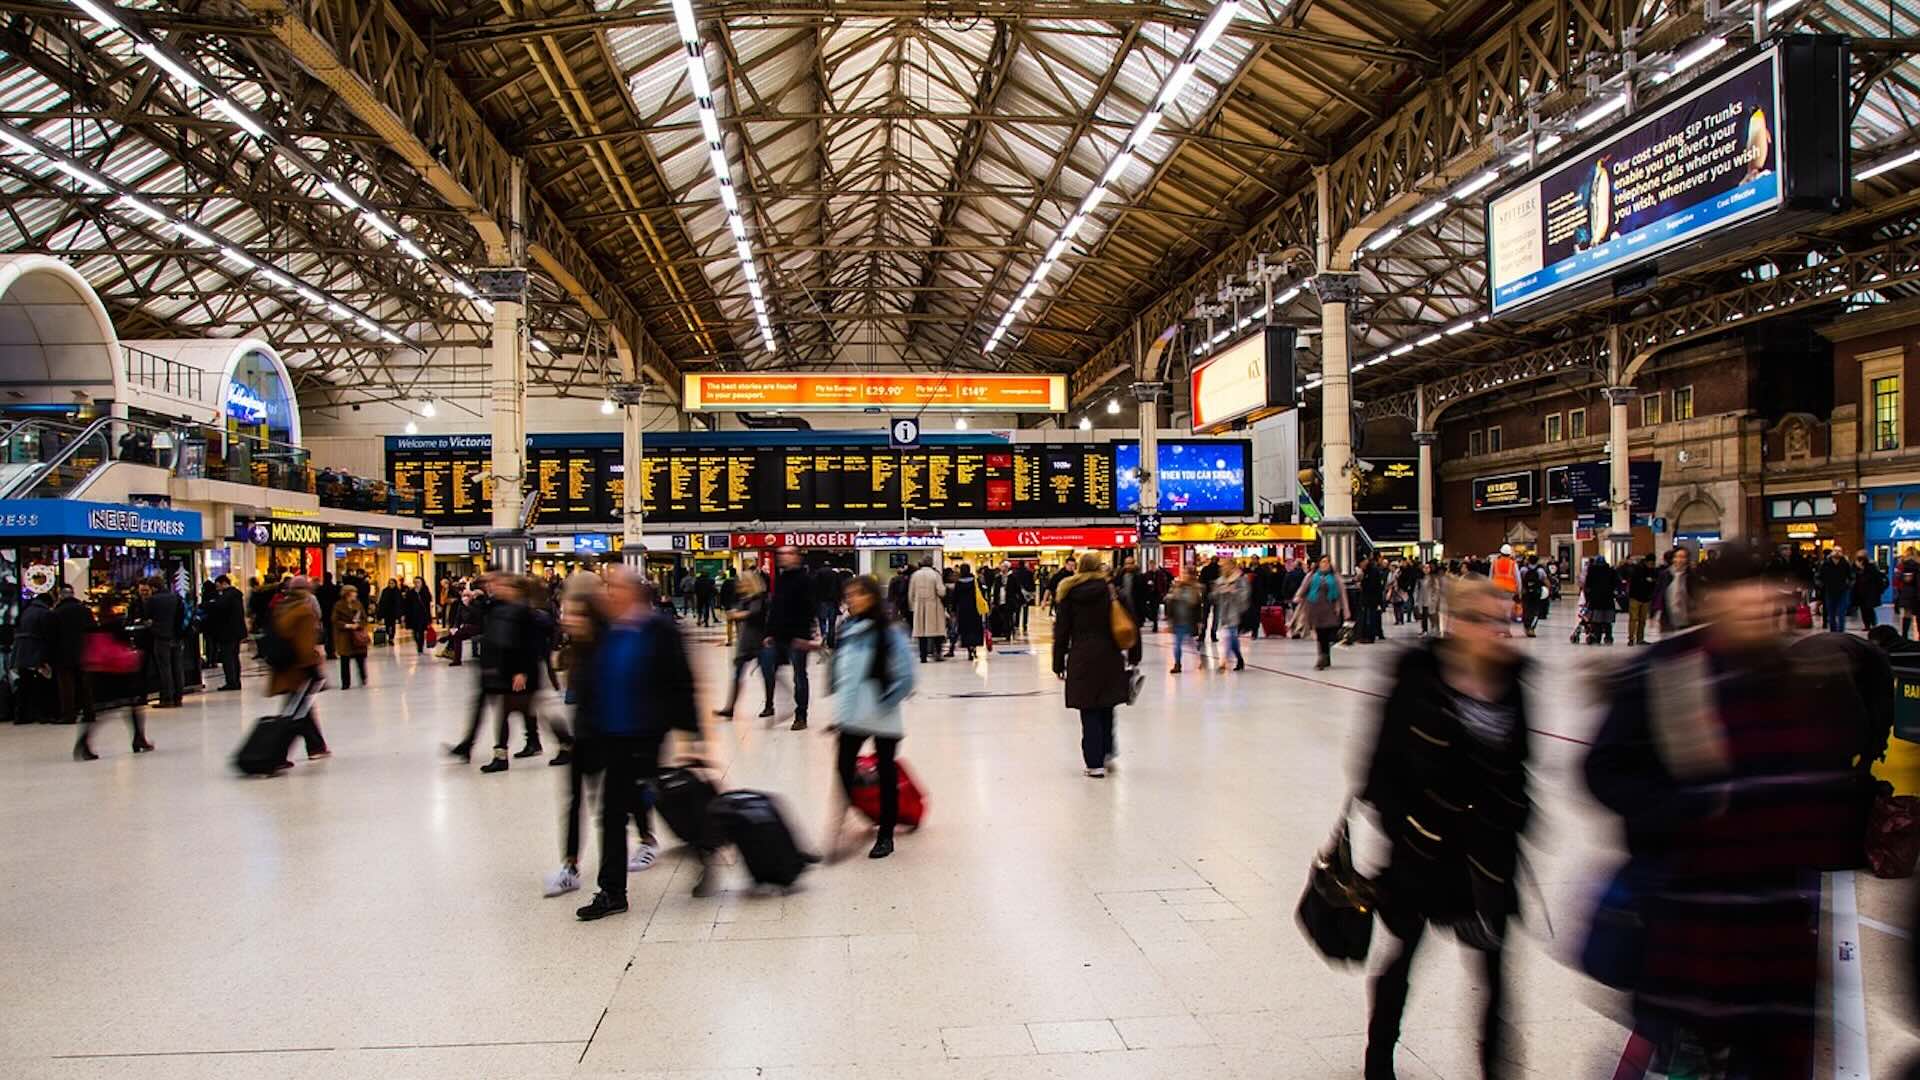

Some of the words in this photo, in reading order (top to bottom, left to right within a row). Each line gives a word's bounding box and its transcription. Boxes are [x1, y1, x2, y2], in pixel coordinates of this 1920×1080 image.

[1613, 159, 1630, 175] Our
[1631, 148, 1651, 166] cost
[1652, 131, 1684, 156] saving
[1685, 121, 1702, 139] SIP
[1704, 101, 1743, 129] Trunks
[1614, 167, 1645, 190] enable
[1645, 158, 1664, 179] you
[1664, 152, 1676, 166] to
[1678, 135, 1708, 160] divert
[1710, 122, 1736, 148] your
[1614, 176, 1660, 205] telephone
[1661, 164, 1684, 184] calls
[1685, 139, 1737, 172] wherever
[1614, 206, 1632, 223] you
[1633, 193, 1657, 212] wish,
[1658, 169, 1709, 198] whenever
[1710, 160, 1732, 182] you
[1733, 144, 1760, 167] wish
[1717, 198, 1729, 209] Cost
[1730, 188, 1757, 204] Effective
[706, 382, 720, 390] The
[721, 382, 737, 390] best
[738, 382, 762, 390] stories
[776, 382, 797, 390] found
[398, 438, 437, 449] Welcome
[439, 439, 448, 449] to
[449, 436, 491, 447] Victoria
[1161, 470, 1181, 480] WHEN
[1182, 470, 1196, 480] YOU
[1197, 470, 1211, 480] CAN
[140, 518, 185, 535] EXPRESS
[272, 523, 320, 543] MONSOON
[470, 540, 481, 550] 10
[674, 536, 684, 547] 12
[785, 533, 847, 546] BURGER
[1018, 531, 1040, 544] GX
